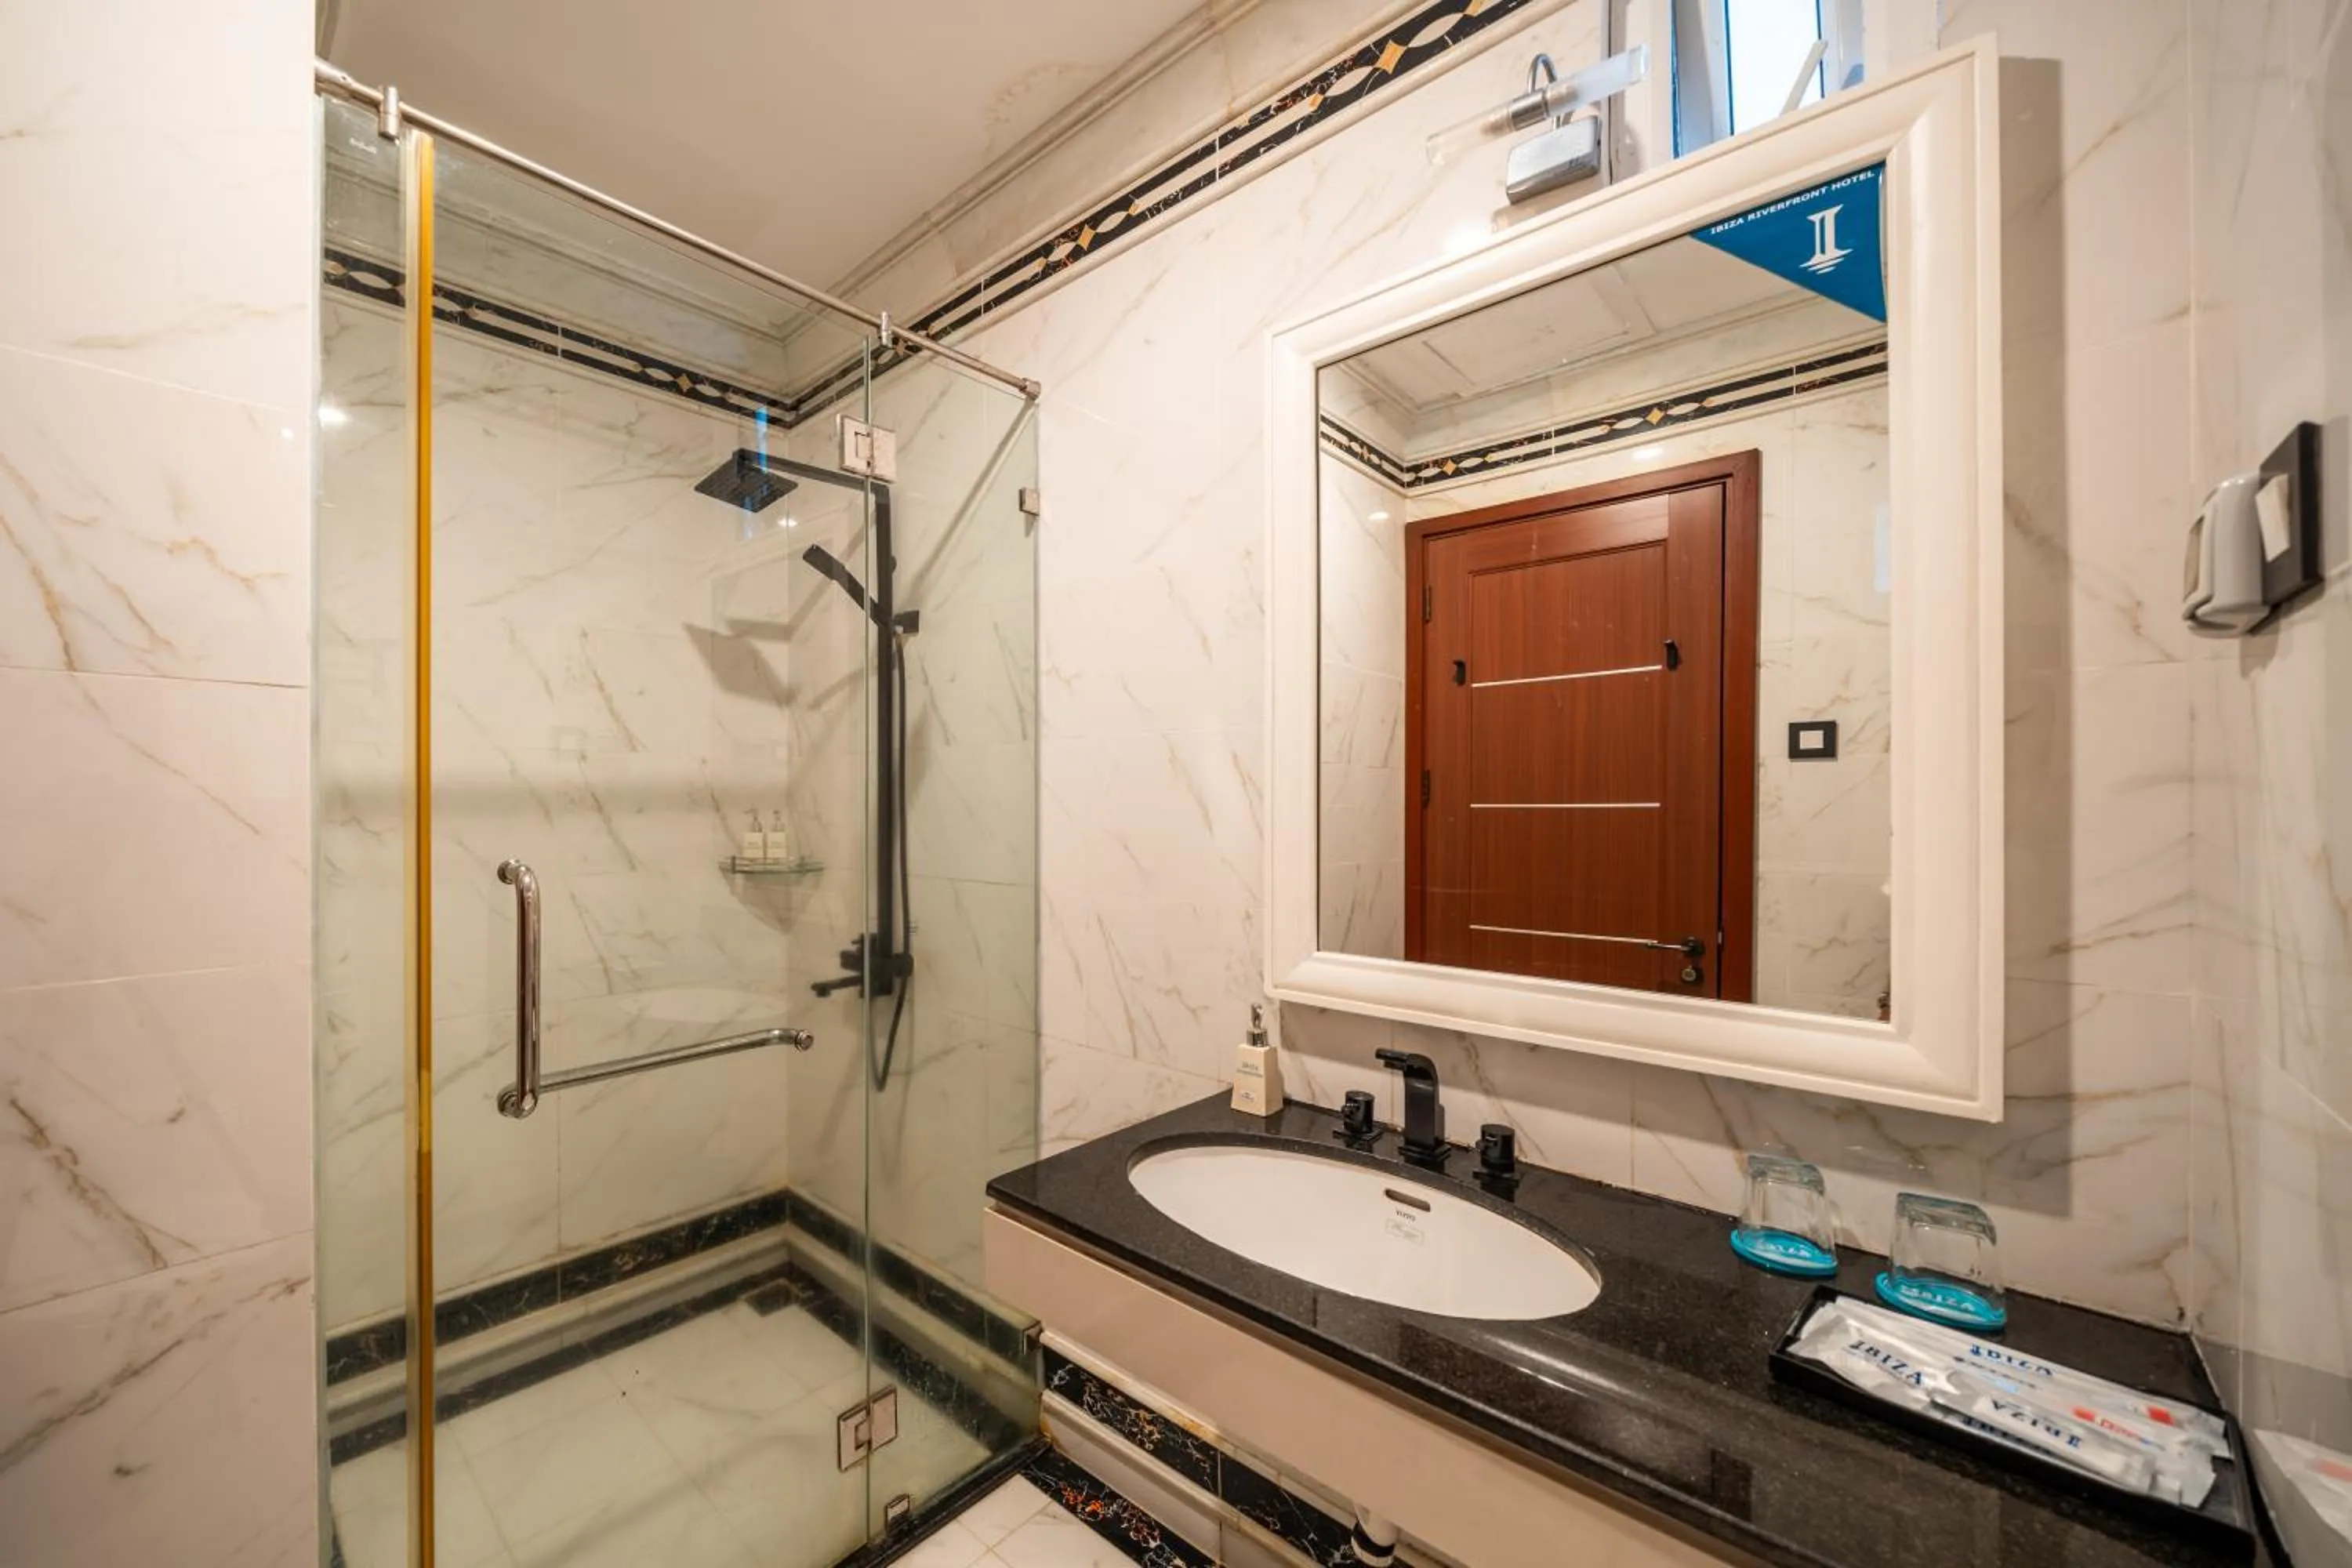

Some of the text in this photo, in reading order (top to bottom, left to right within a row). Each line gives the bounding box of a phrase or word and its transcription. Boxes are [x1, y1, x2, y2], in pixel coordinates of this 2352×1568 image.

[1711, 170, 1875, 234] IBIZA RIVERFRONT HOTEL
[1849, 1340, 1923, 1385] IBIZA
